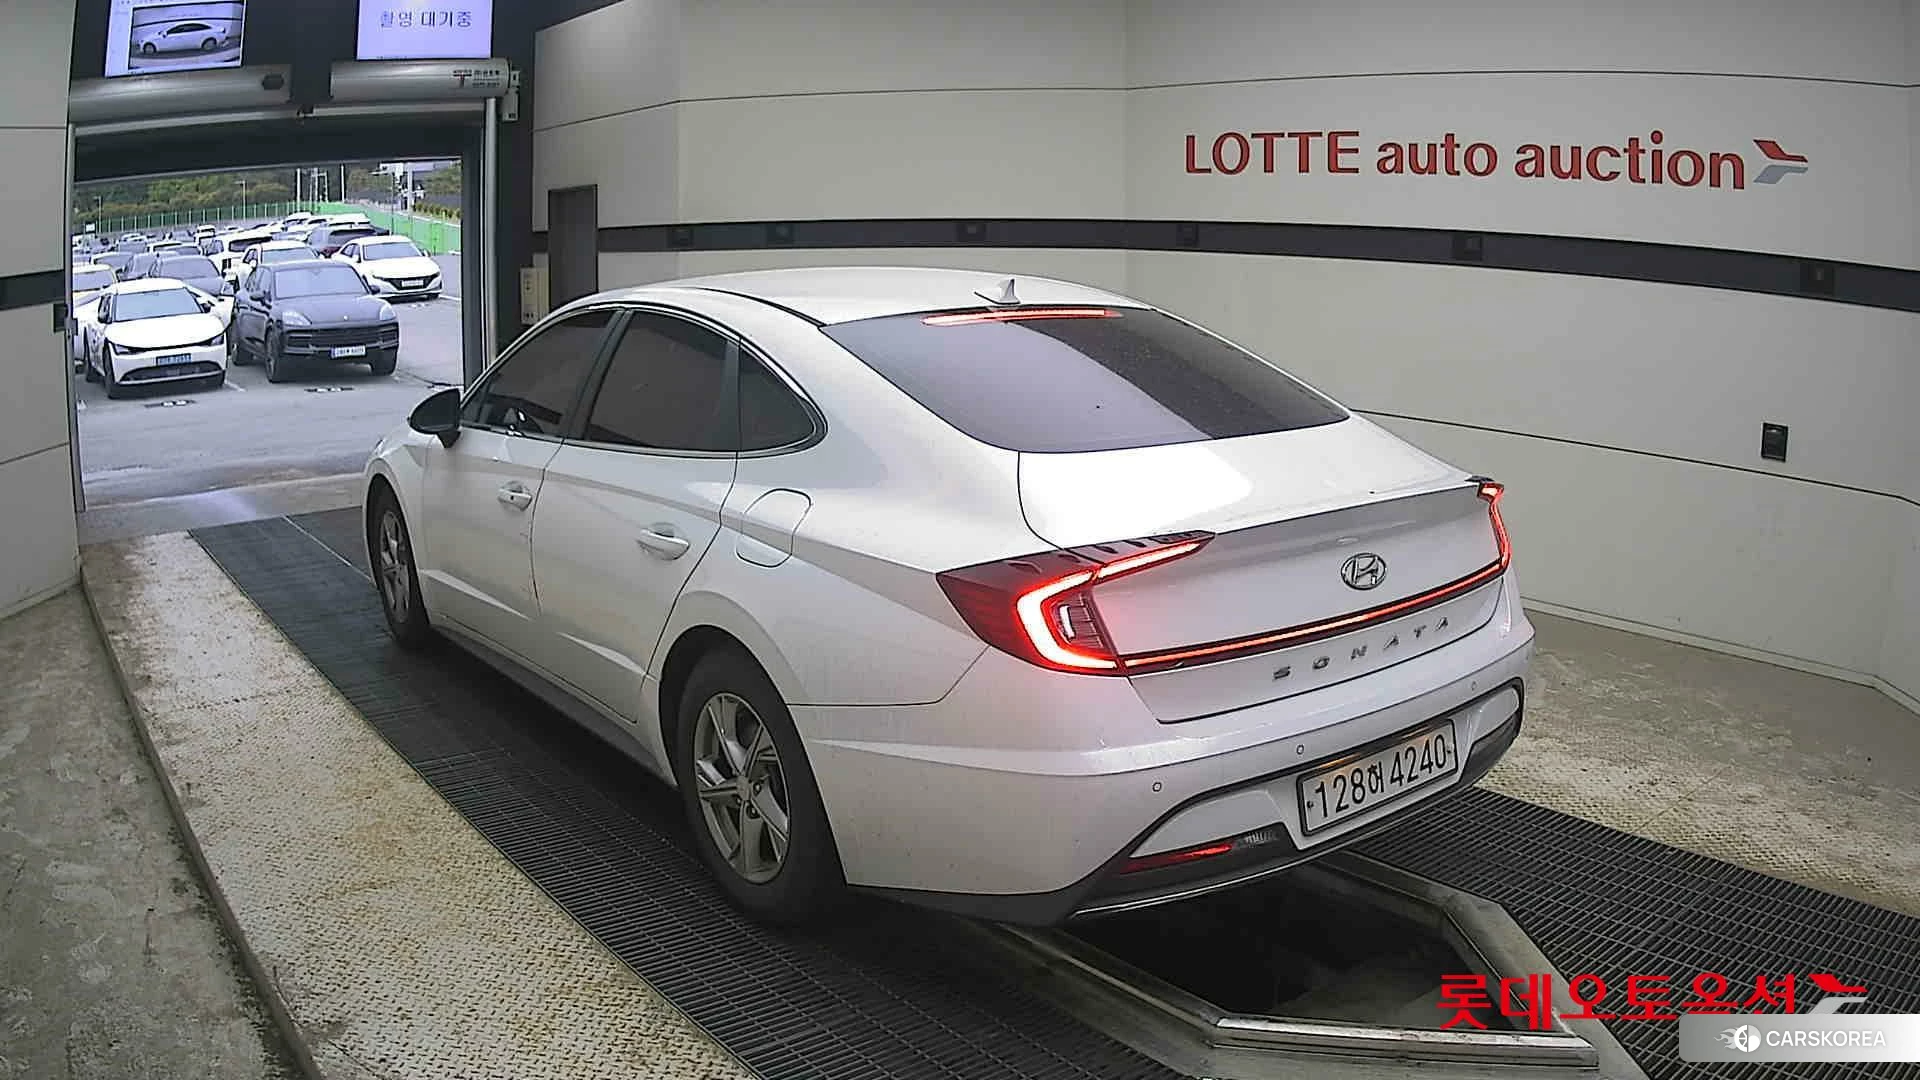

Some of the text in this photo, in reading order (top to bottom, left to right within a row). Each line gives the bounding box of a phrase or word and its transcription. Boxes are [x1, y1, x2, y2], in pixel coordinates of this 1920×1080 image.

[421, 11, 471, 27] 대기중
[1185, 130, 1745, 189] LOTTE auto auction
[1273, 616, 1449, 680] SONATA
[1390, 734, 1447, 787] 4240
